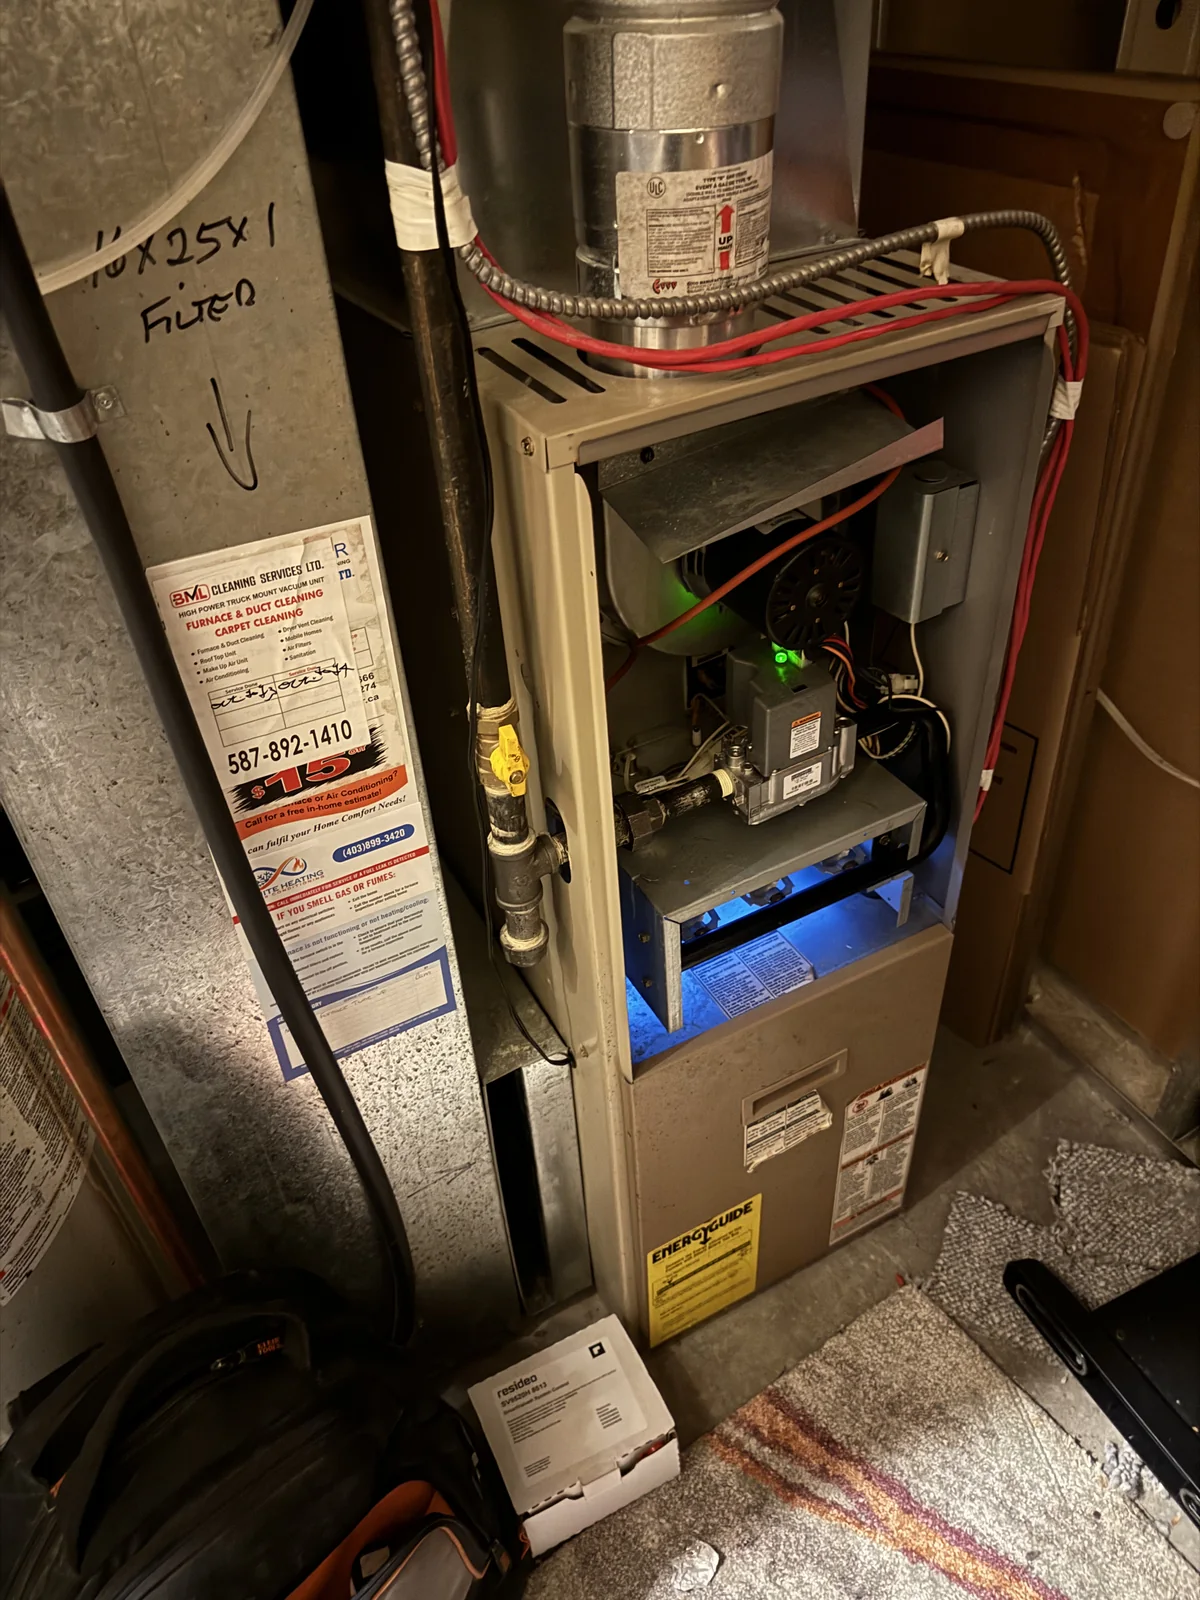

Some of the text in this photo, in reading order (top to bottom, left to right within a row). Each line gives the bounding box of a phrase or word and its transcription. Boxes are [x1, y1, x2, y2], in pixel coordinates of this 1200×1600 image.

[649, 181, 664, 195] ULC
[718, 235, 733, 245] UP
[172, 559, 325, 606] BML CLEANING SERVICES LTD.
[178, 576, 325, 619] HIGH POWER TRUCK MOUNT VACUUM UNIT
[185, 588, 324, 631] FURNACE & DUCT CLEANING
[215, 607, 304, 637] CARPET CLEANING
[282, 615, 334, 634] Dryer Vent Cleaning
[197, 644, 220, 655] Furnace
[226, 639, 240, 647] Duct
[240, 632, 265, 644] Cleaning
[285, 628, 322, 642] Mobile Homes
[295, 640, 312, 649] Filters
[200, 656, 213, 664] Roof
[289, 649, 316, 661] Sanitation
[202, 666, 218, 674] Make
[214, 667, 249, 680] Conditioning
[288, 668, 306, 676] Service
[225, 686, 244, 694] Service
[227, 719, 353, 775] 587-892-1410
[315, 795, 325, 803] or
[325, 792, 340, 801] Air
[340, 770, 399, 797] Conditioning?
[245, 817, 263, 829] Call
[264, 813, 278, 822] for
[287, 807, 305, 817] free
[307, 801, 343, 813] in-home
[344, 788, 383, 805] estimate!
[247, 795, 407, 855] can fulfil your Home Comfort Needs!
[342, 828, 406, 859] (403)899-3420
[280, 869, 325, 889] HEATING
[332, 876, 353, 888] SERVICE
[363, 867, 375, 876] FUEL
[376, 863, 387, 872] LEAK
[393, 852, 417, 864] DETECTED
[276, 871, 397, 921] IF YOU SMELL GAS OR FUMES:
[304, 942, 311, 950] is
[311, 938, 324, 948] not
[324, 924, 361, 943] functioning
[369, 915, 380, 925] not
[652, 1200, 753, 1265] ENERGYGUIDE
[496, 1373, 538, 1398] resideo
